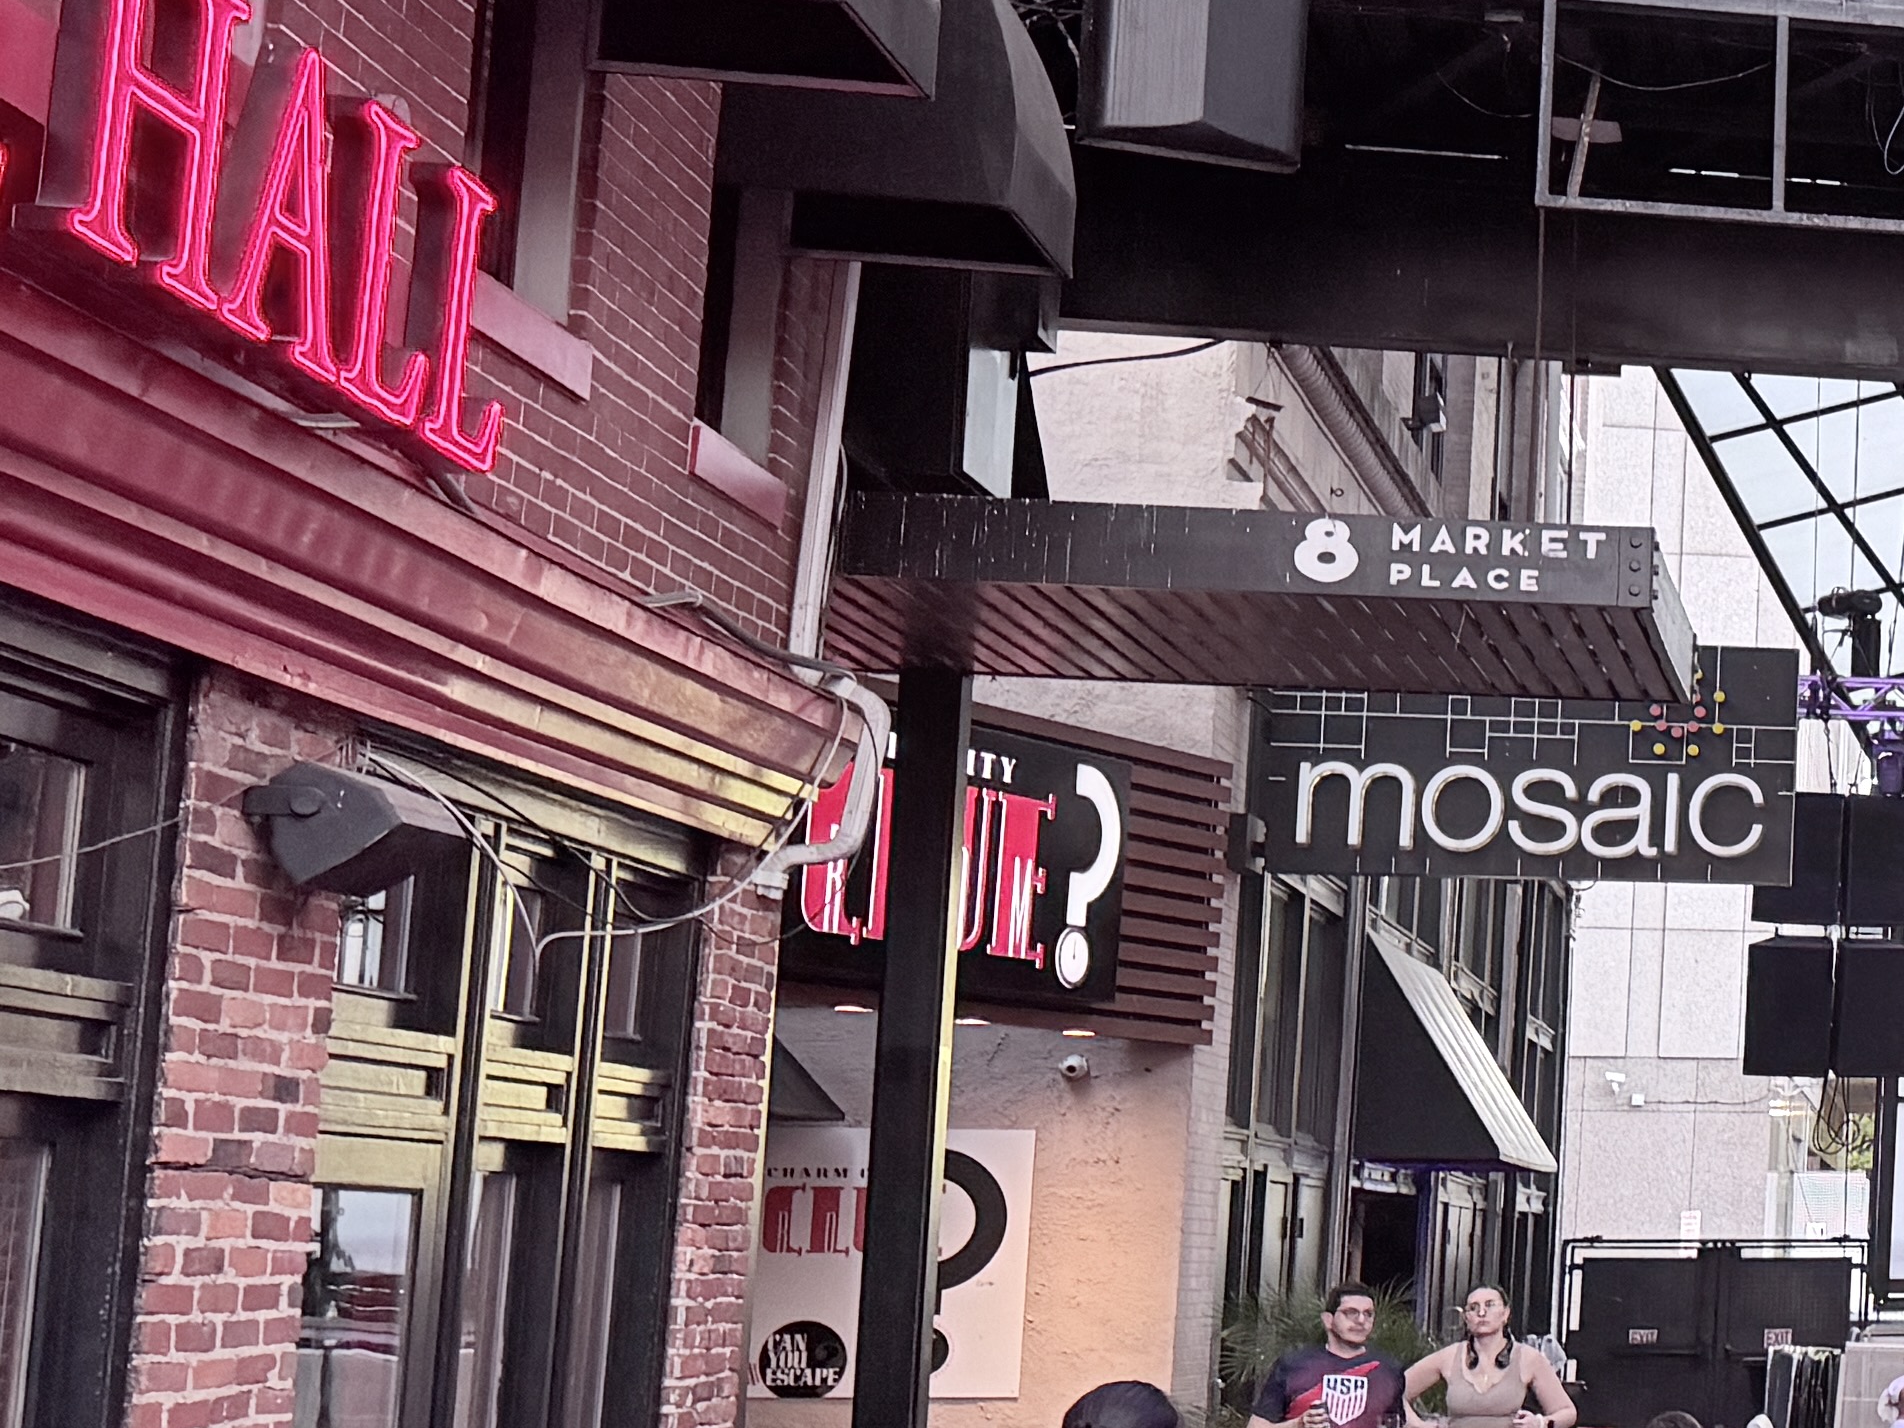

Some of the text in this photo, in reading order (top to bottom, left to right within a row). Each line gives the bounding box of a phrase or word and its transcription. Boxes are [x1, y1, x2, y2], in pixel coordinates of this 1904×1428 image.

[1293, 517, 1360, 584] 8
[1390, 522, 1607, 560] MARKET
[1388, 562, 1540, 592] PLACE
[966, 749, 1017, 784] ITY
[1295, 760, 1766, 859] mosaic
[766, 1333, 808, 1352] CAN
[1766, 1330, 1791, 1346] EXIT
[766, 1350, 809, 1369] YOU
[765, 1367, 841, 1387] ESCAPE
[1326, 1377, 1365, 1395] USA
